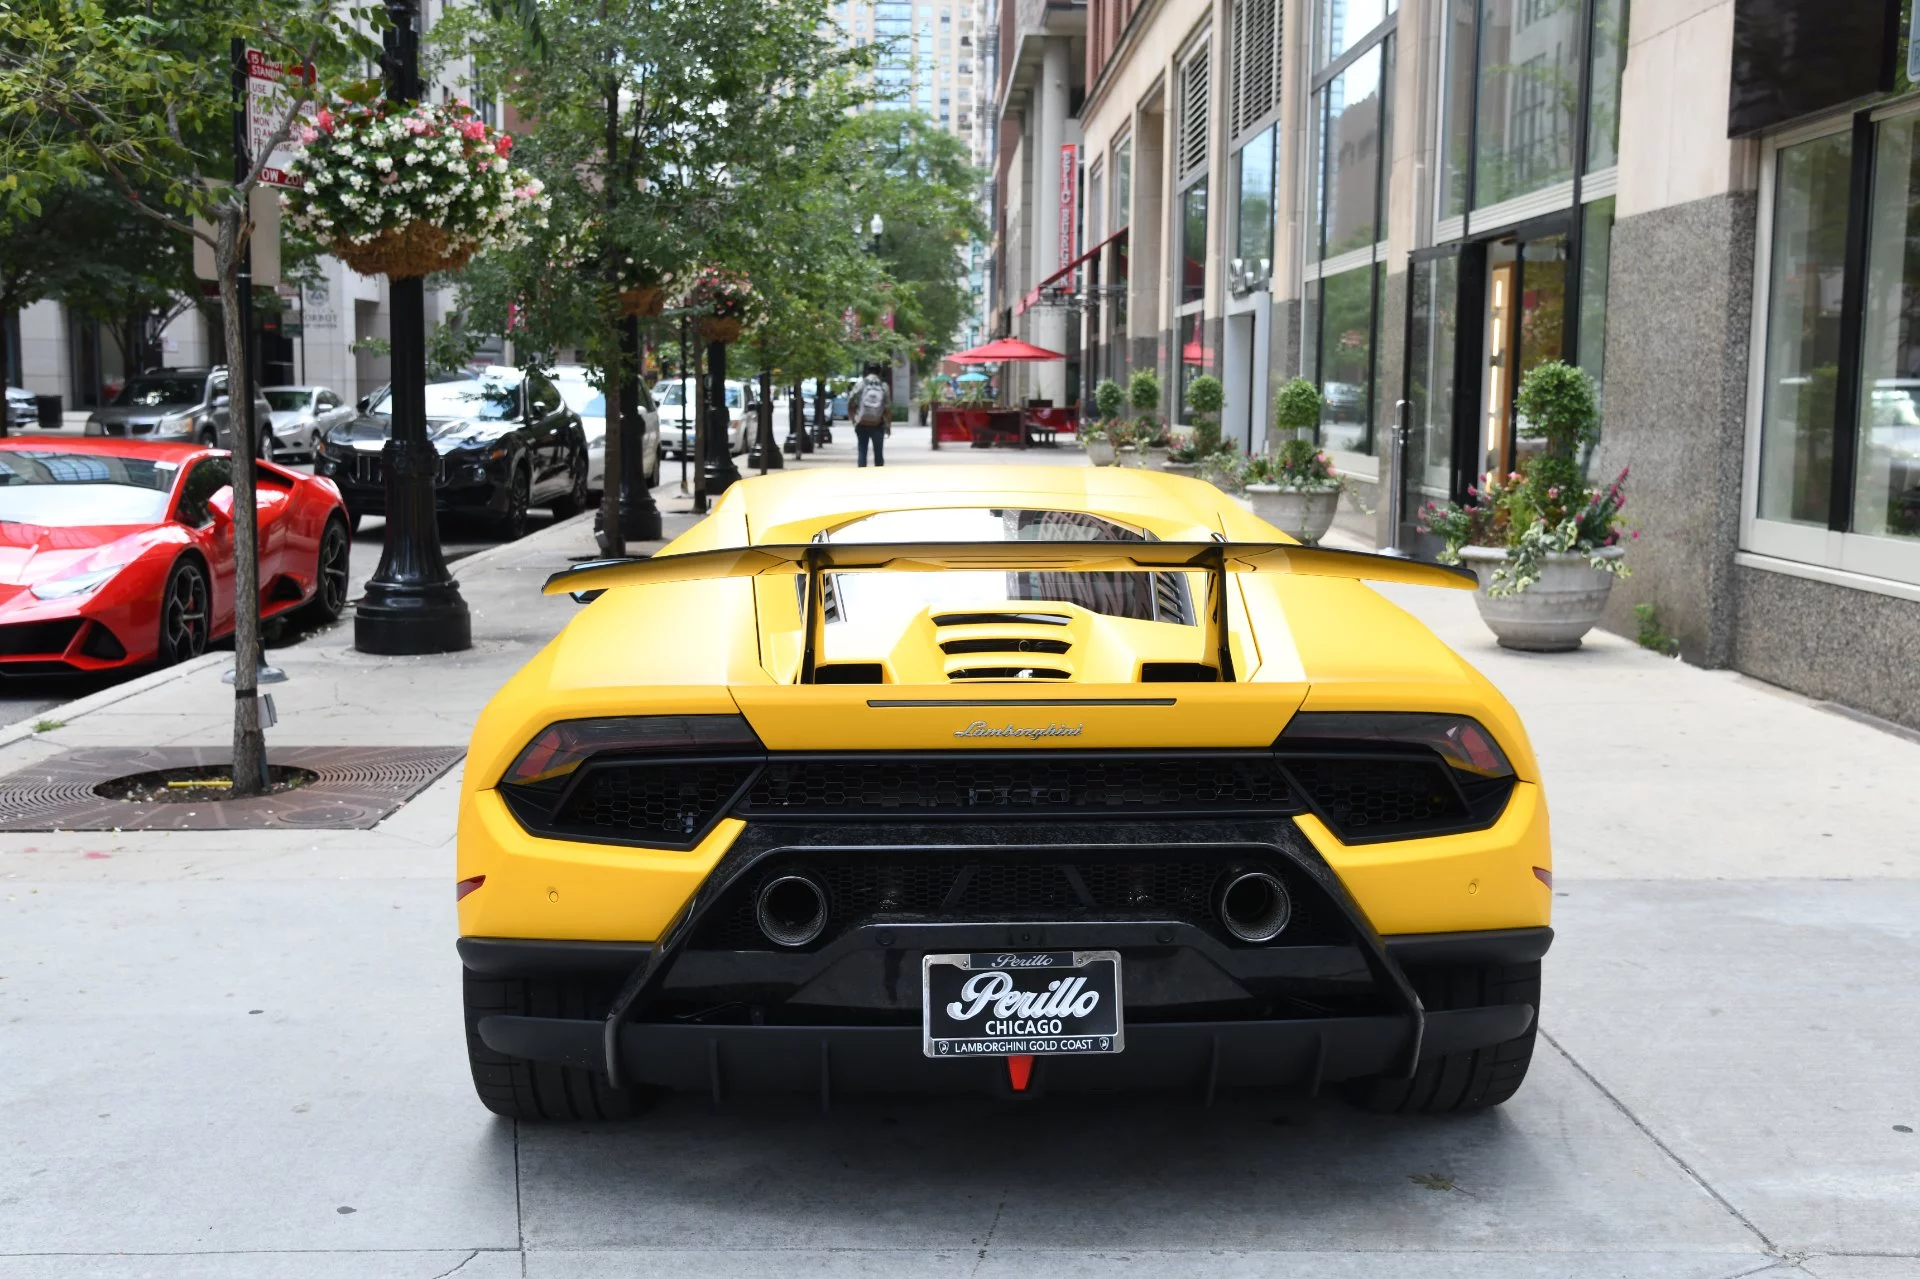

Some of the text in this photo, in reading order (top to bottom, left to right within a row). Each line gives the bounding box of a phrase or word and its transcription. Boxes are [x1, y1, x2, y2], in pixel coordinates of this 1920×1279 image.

[252, 83, 267, 94] USE
[253, 116, 270, 127] MON
[954, 720, 1084, 741] Lamborghini
[991, 953, 1053, 968] Perillo
[946, 971, 1100, 1021] Perillo
[985, 1019, 1062, 1035] CHICAGO
[955, 1039, 1093, 1053] LAMBORGHINI GOLD COAST
